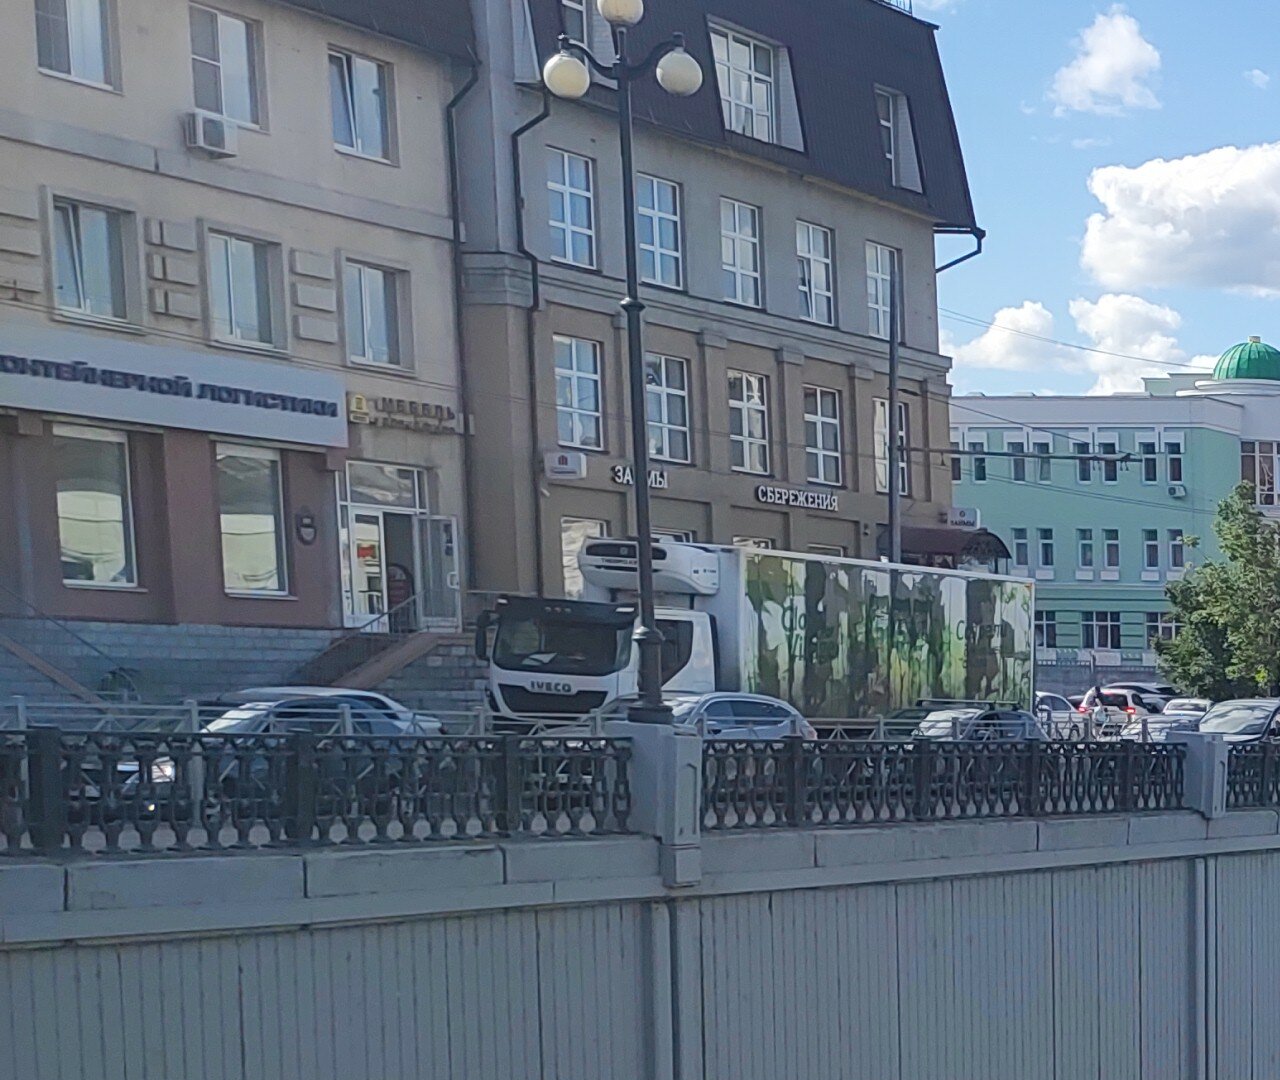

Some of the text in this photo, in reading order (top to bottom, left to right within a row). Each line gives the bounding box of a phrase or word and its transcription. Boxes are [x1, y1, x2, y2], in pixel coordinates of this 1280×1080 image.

[0, 354, 193, 397] ОНТЕЙНЕРНОЙ
[613, 465, 668, 488] ЗАМЫ
[757, 485, 839, 512] СБЕРЕЖЕНИЯ
[530, 680, 572, 693] IVECO
